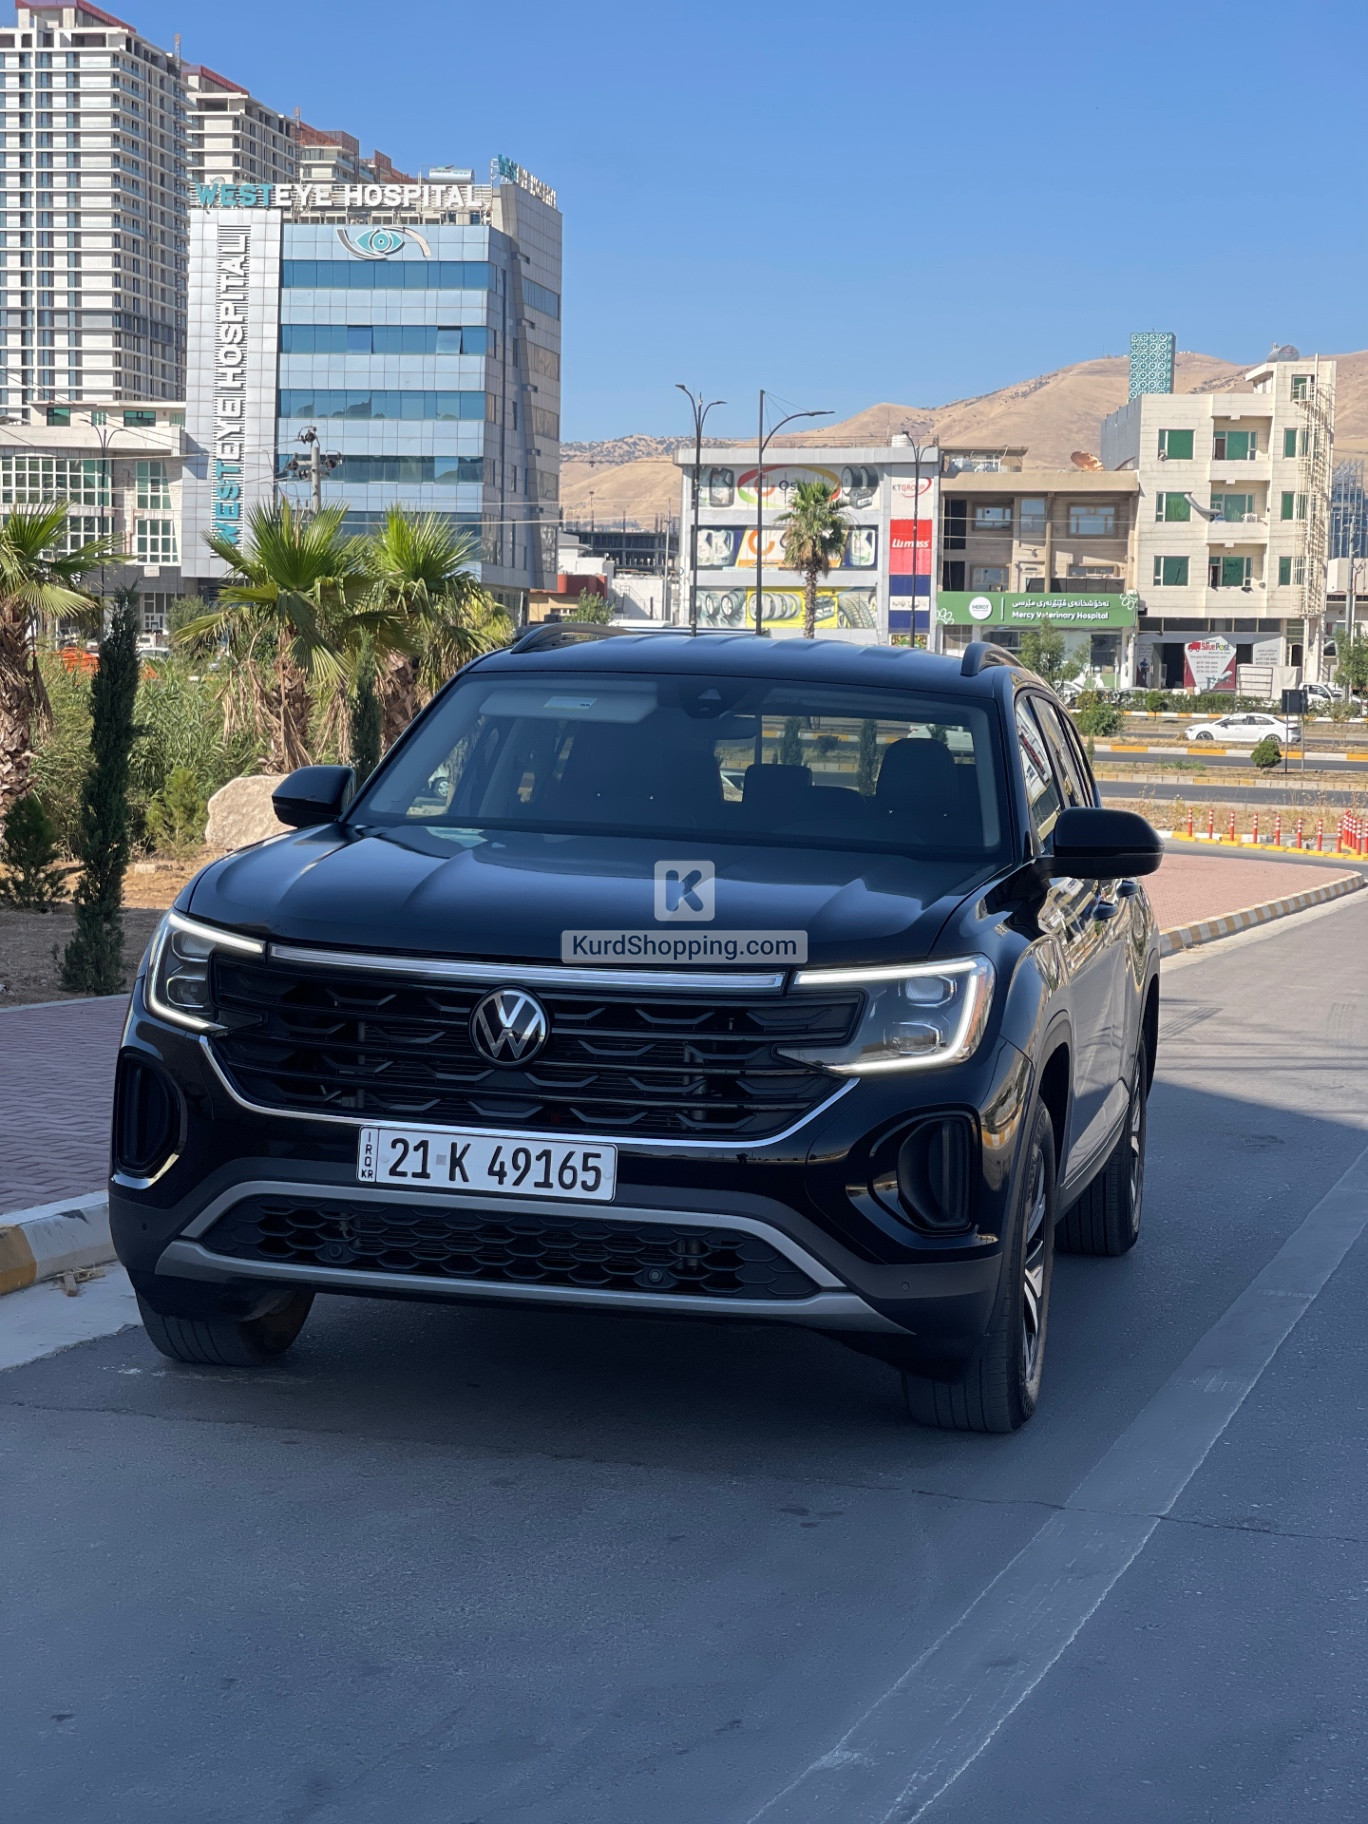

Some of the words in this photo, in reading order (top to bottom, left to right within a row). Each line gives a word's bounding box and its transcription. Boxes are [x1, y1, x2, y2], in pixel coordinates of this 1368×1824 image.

[344, 183, 483, 207] HOSPITAL
[217, 234, 247, 390] HOSPITAL
[1012, 611, 1035, 620] Mercy
[1077, 611, 1109, 620] Hospital
[361, 1168, 374, 1179] KR
[388, 1137, 431, 1179] 21
[448, 1141, 471, 1182] K
[487, 1145, 602, 1192] 49165
